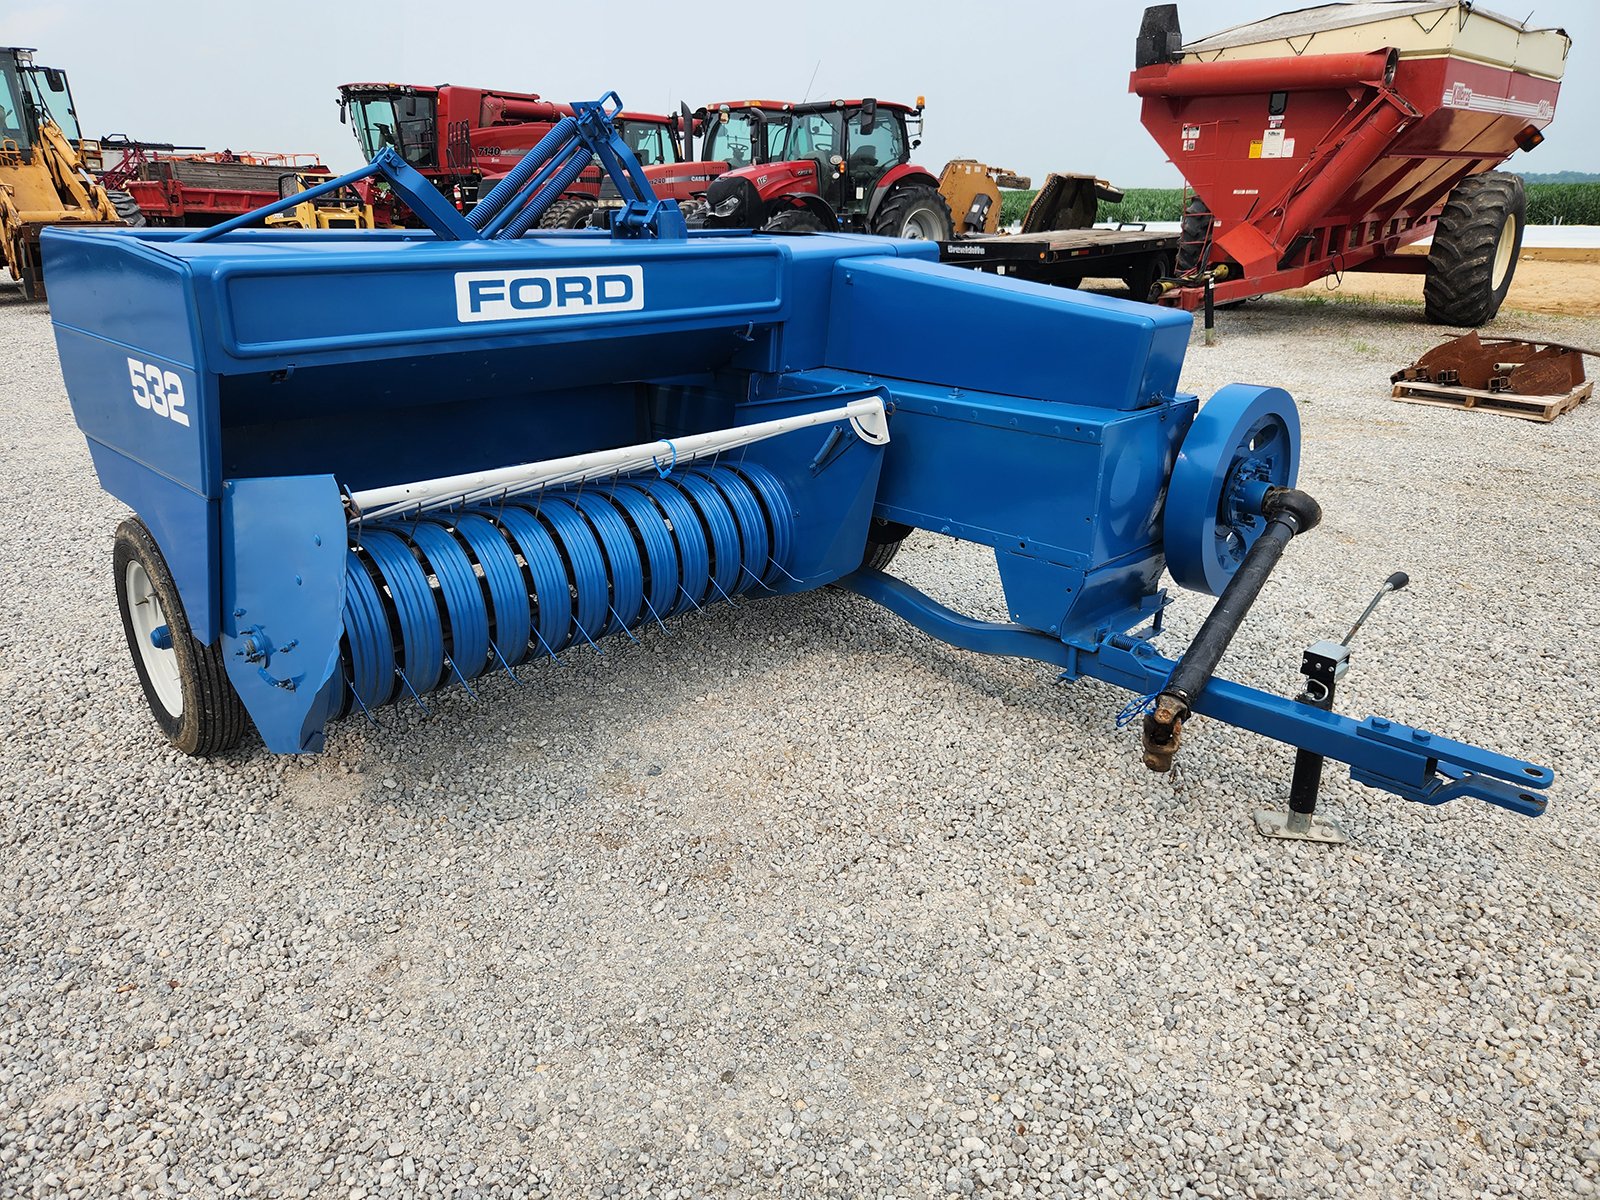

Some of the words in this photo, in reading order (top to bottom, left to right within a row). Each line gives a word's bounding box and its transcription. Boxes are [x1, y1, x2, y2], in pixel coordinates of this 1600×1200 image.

[478, 146, 501, 156] 7140
[468, 274, 634, 313] FORD
[127, 356, 190, 427] 532
